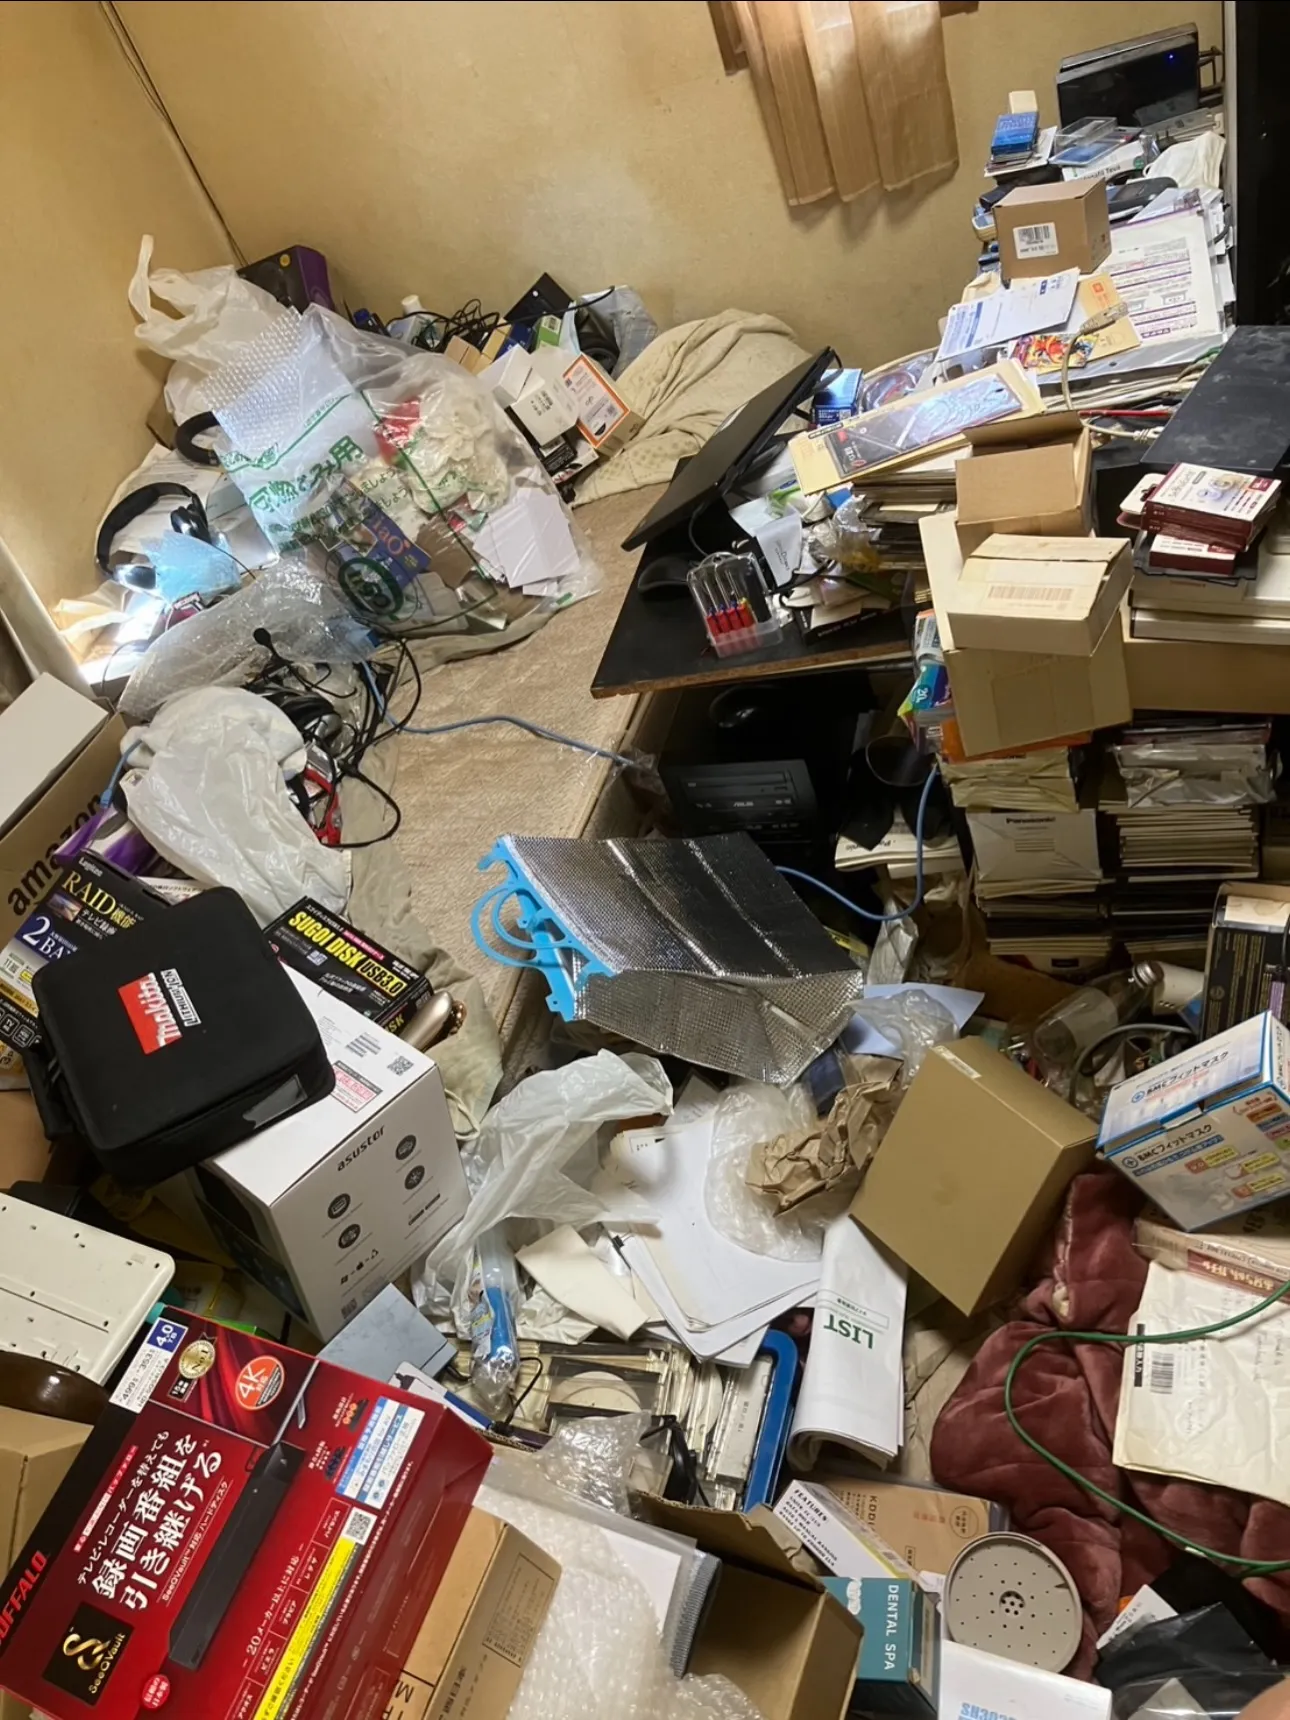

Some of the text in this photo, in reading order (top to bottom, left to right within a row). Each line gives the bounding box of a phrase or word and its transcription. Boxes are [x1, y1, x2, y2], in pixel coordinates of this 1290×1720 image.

[287, 910, 335, 947] SUGOI
[325, 936, 366, 968] DISK
[359, 961, 404, 995] USB3.0
[137, 970, 182, 1047] makita
[336, 1123, 387, 1172] asustor
[1137, 1122, 1213, 1162] BMCフィットマスク
[153, 1322, 174, 1348] 4.0
[823, 1313, 872, 1349] LIST
[234, 1360, 267, 1401] 4K
[88, 1430, 199, 1601] 録画番組を
[117, 1445, 226, 1615] 引き継げる
[0, 1549, 48, 1639] UFFALO
[884, 1584, 899, 1669] DENTAL SPA
[86, 1630, 127, 1695] SeeQVault
